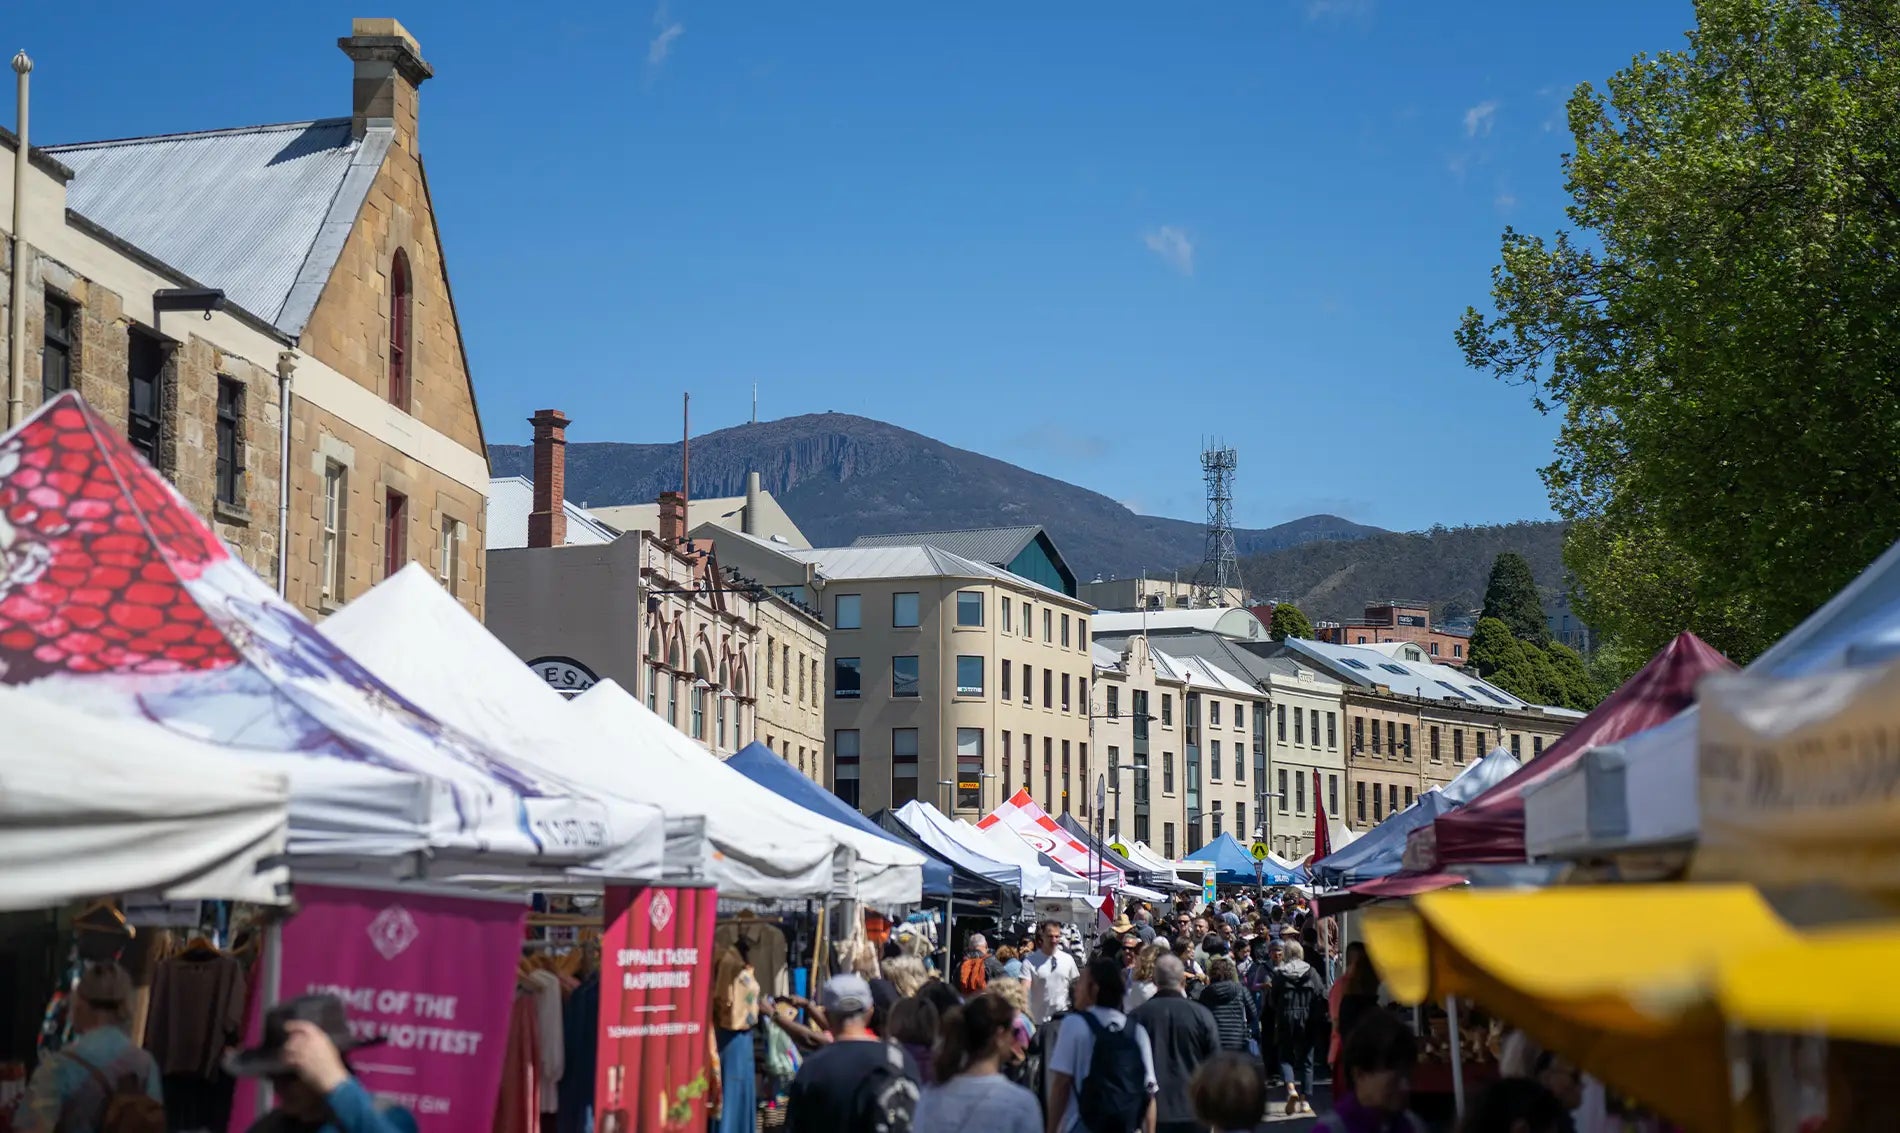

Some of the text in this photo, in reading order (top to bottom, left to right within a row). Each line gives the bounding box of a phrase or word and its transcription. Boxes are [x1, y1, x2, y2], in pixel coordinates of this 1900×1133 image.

[623, 971, 690, 989] RASPBERRIES
[377, 989, 410, 1015] OF
[414, 995, 457, 1020] THE
[419, 1096, 450, 1115] GIN
